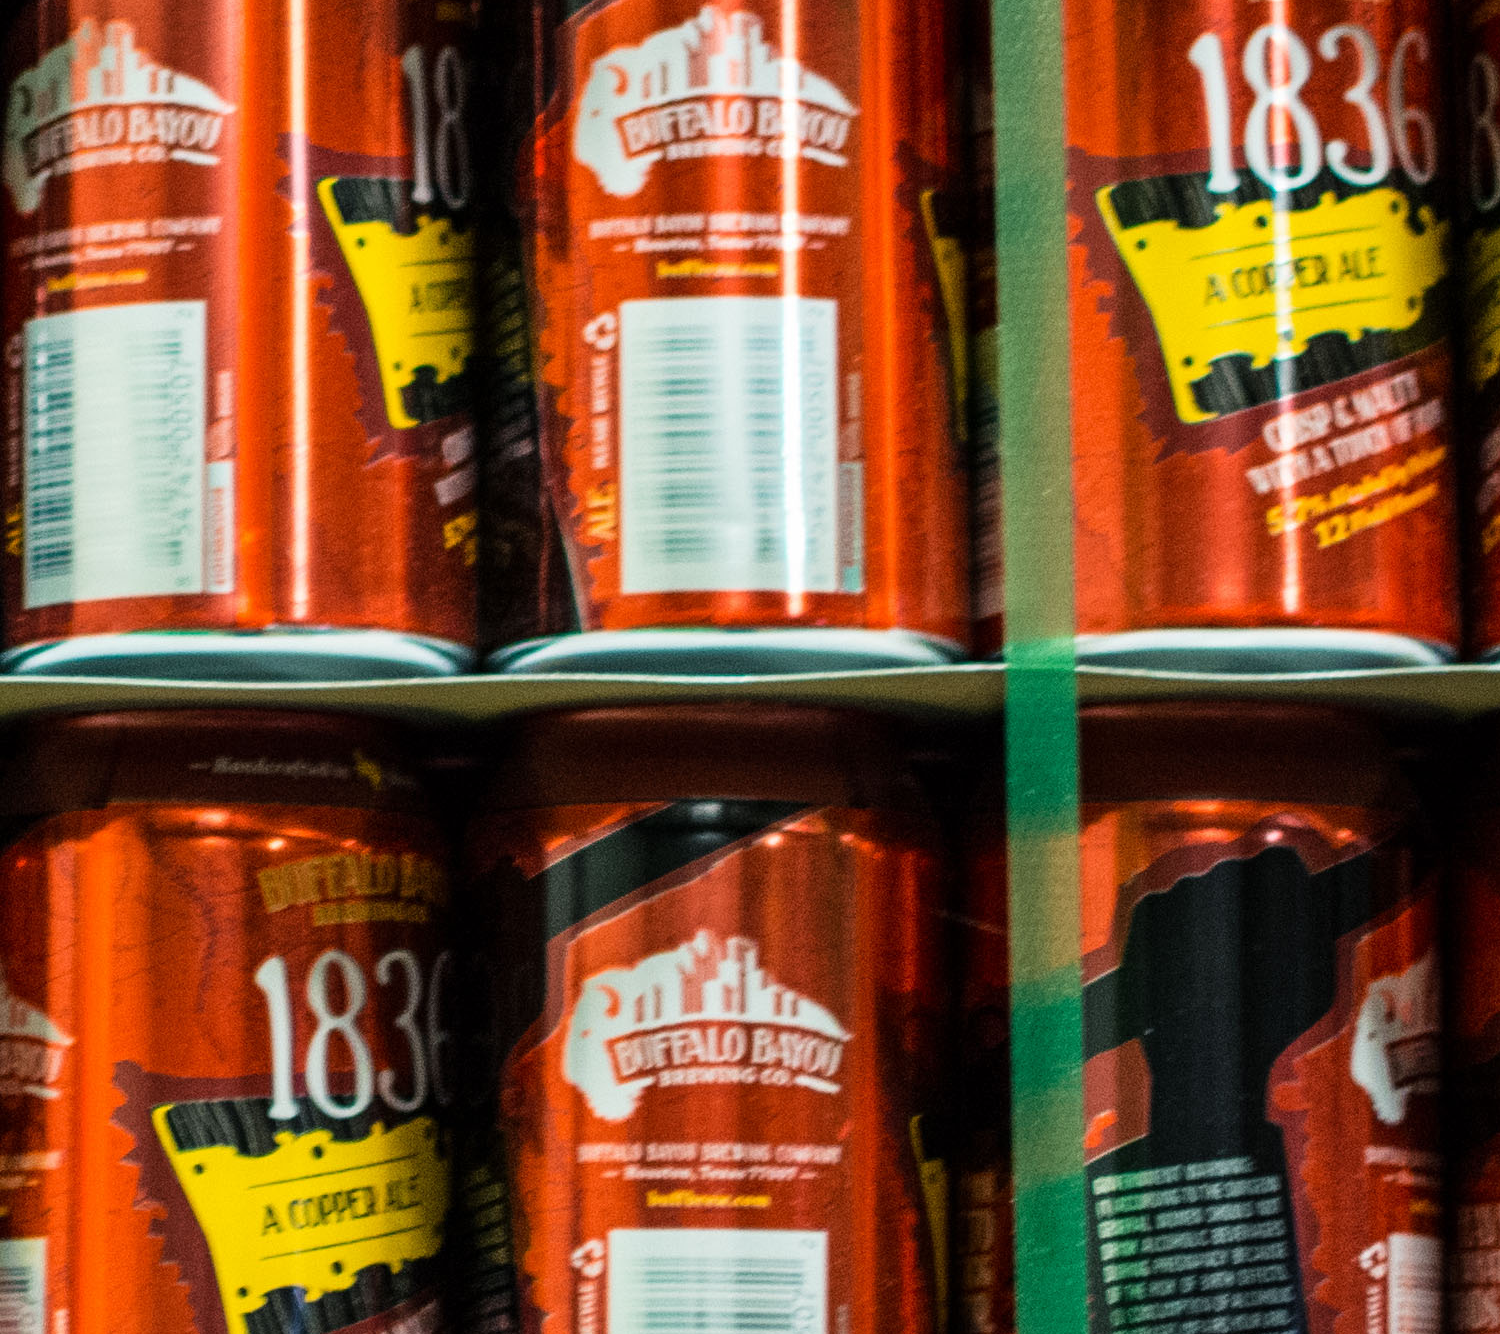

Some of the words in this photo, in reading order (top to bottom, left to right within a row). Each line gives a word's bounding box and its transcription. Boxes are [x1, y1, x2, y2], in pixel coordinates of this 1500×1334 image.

[624, 100, 751, 149] BUFFALO
[760, 98, 849, 145] BAYOU
[1190, 25, 1434, 192] 1836
[1233, 260, 1327, 299] COPPER
[1334, 245, 1387, 279] ALE
[618, 1030, 743, 1077] BUFFALO
[752, 1029, 842, 1075] BAYOU
[289, 1188, 378, 1229] COPPER
